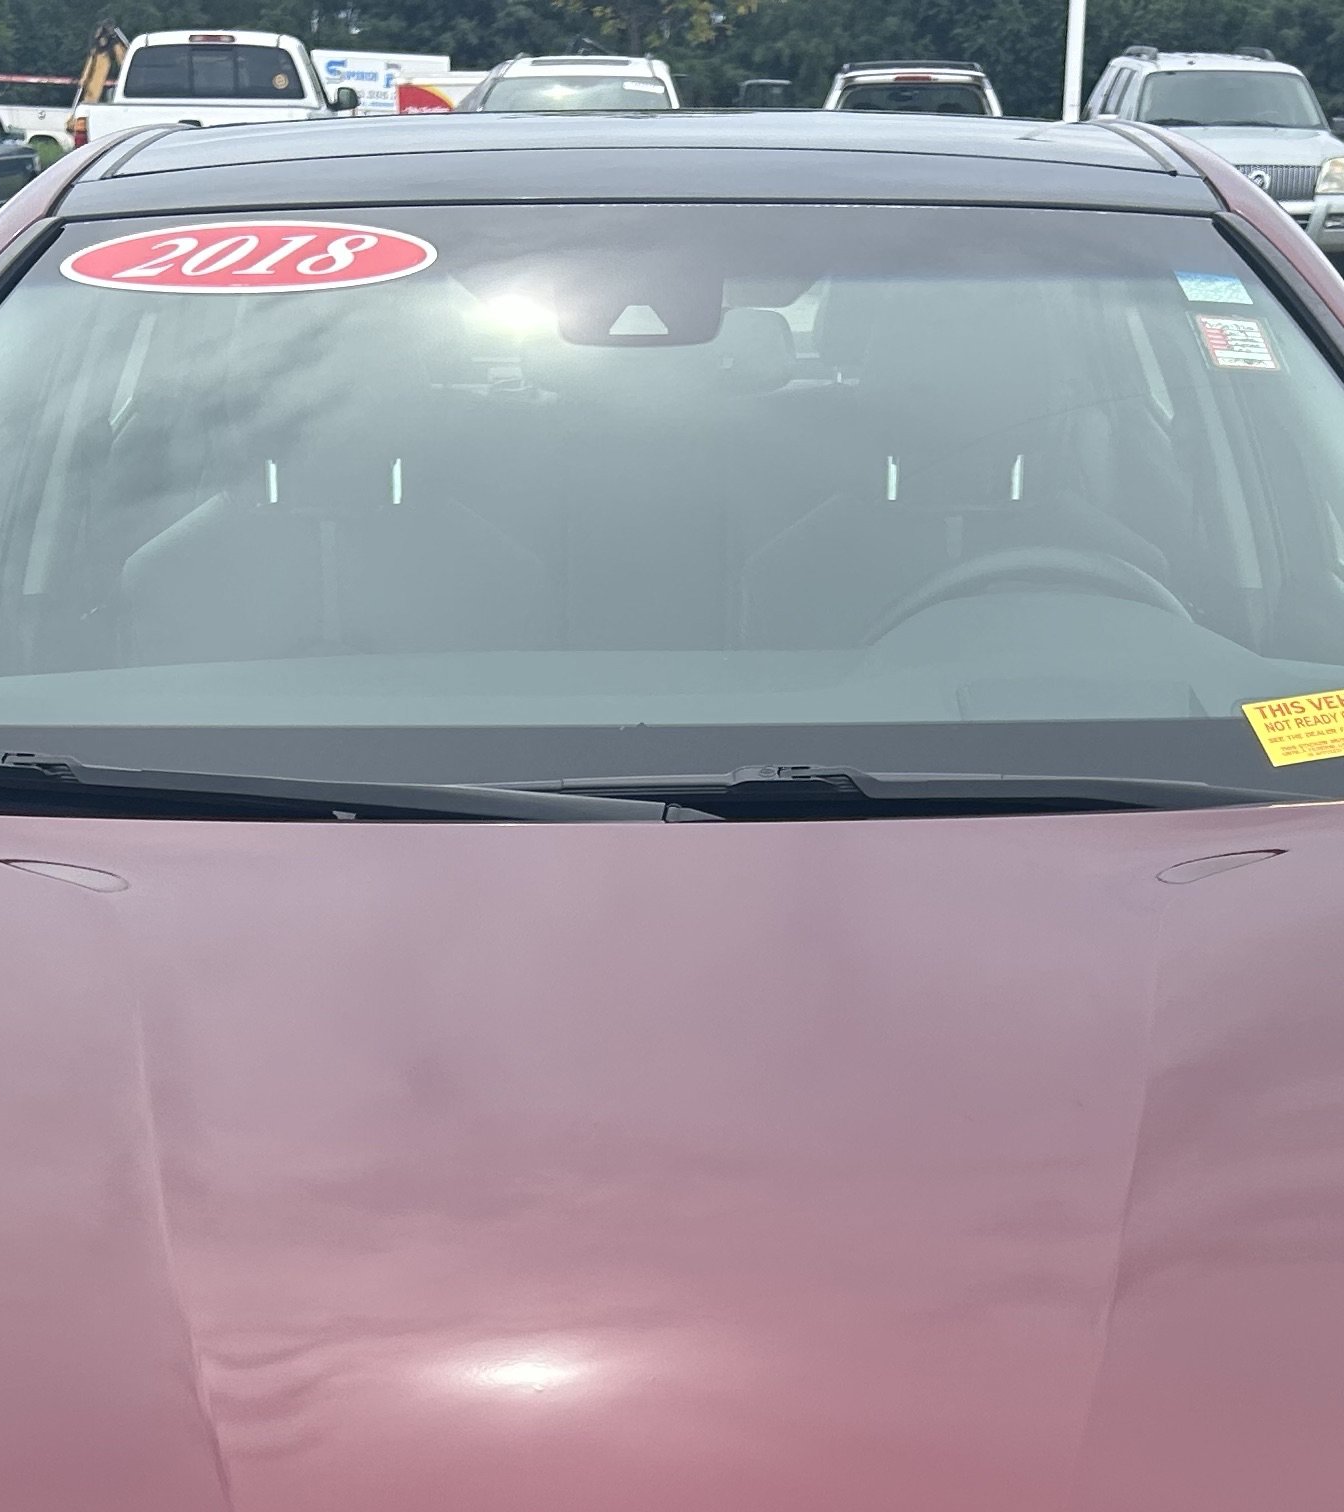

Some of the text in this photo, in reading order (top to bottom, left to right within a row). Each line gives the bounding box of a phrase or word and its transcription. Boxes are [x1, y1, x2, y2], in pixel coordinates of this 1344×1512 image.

[111, 234, 379, 278] 2018
[1253, 700, 1307, 719] THIS
[1262, 719, 1294, 733] NOT
[1293, 712, 1340, 728] READY
[1304, 728, 1337, 738] DEALER
